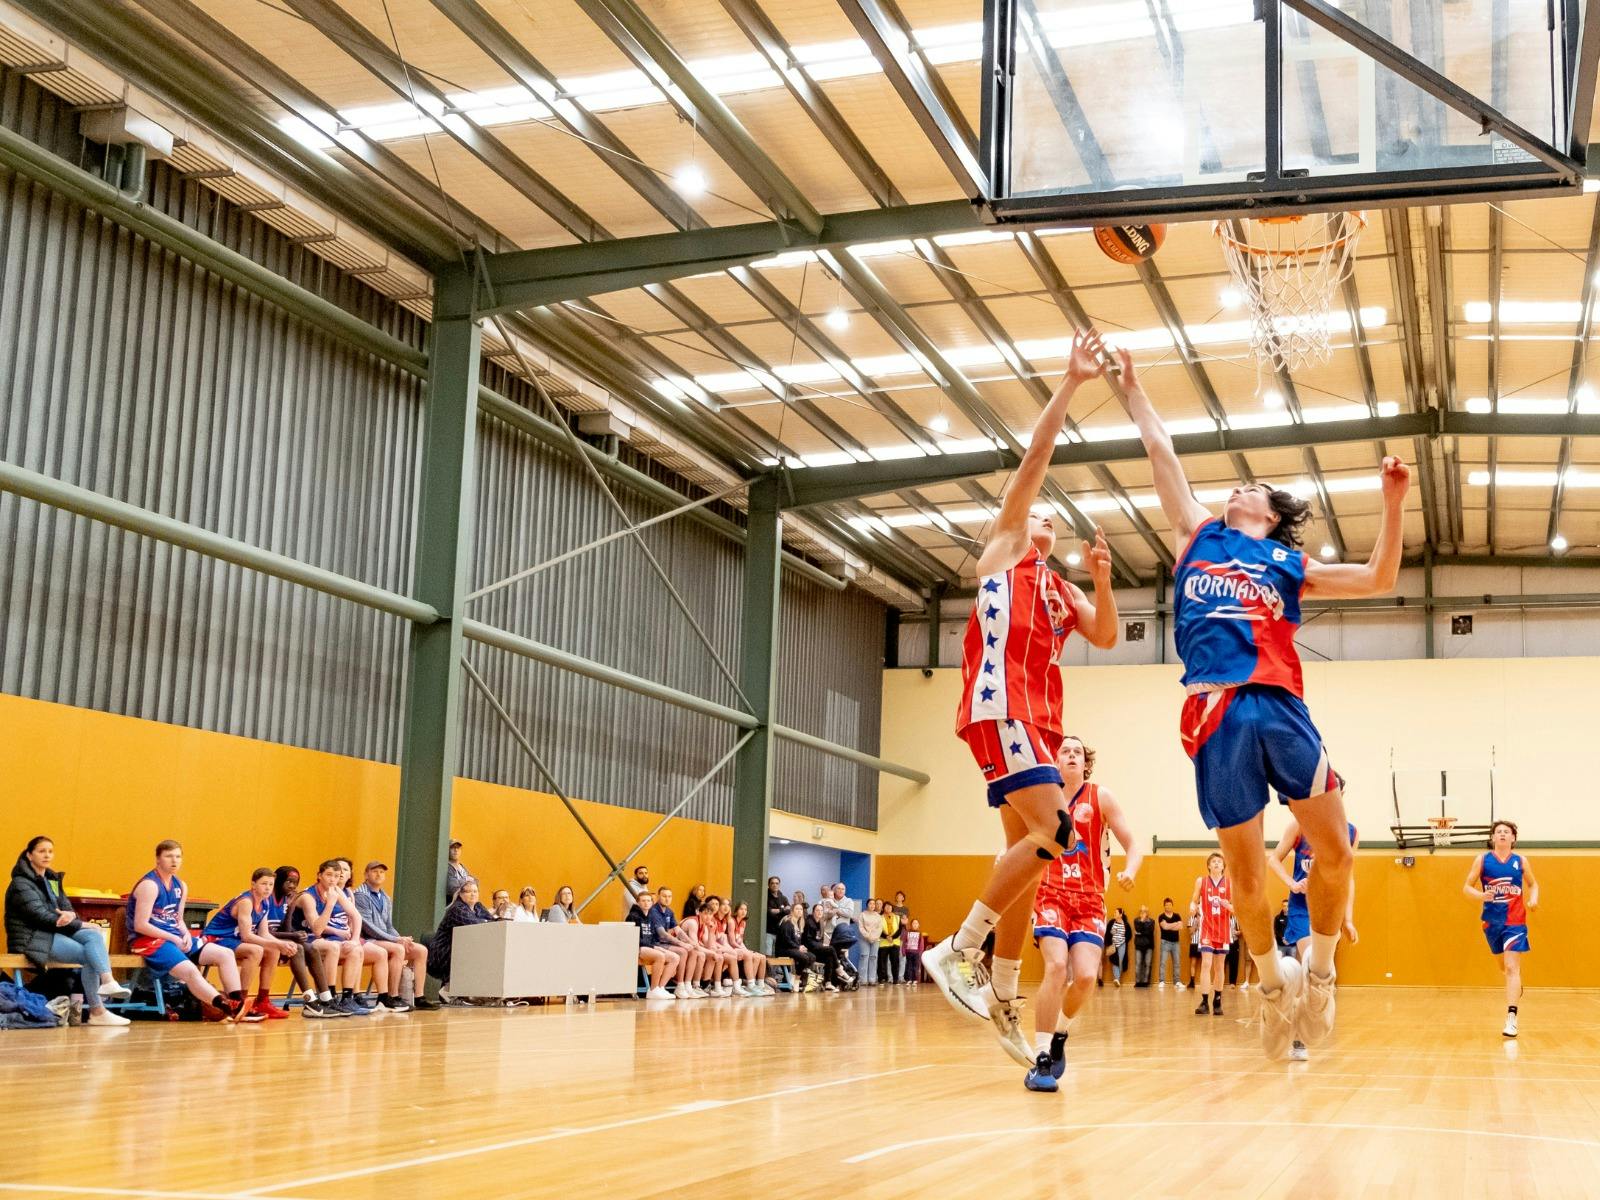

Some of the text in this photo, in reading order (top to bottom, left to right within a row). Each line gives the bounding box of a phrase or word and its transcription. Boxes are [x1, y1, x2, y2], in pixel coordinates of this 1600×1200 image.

[1272, 548, 1288, 561] 8
[1062, 863, 1081, 878] 33
[1512, 860, 1519, 870] 4
